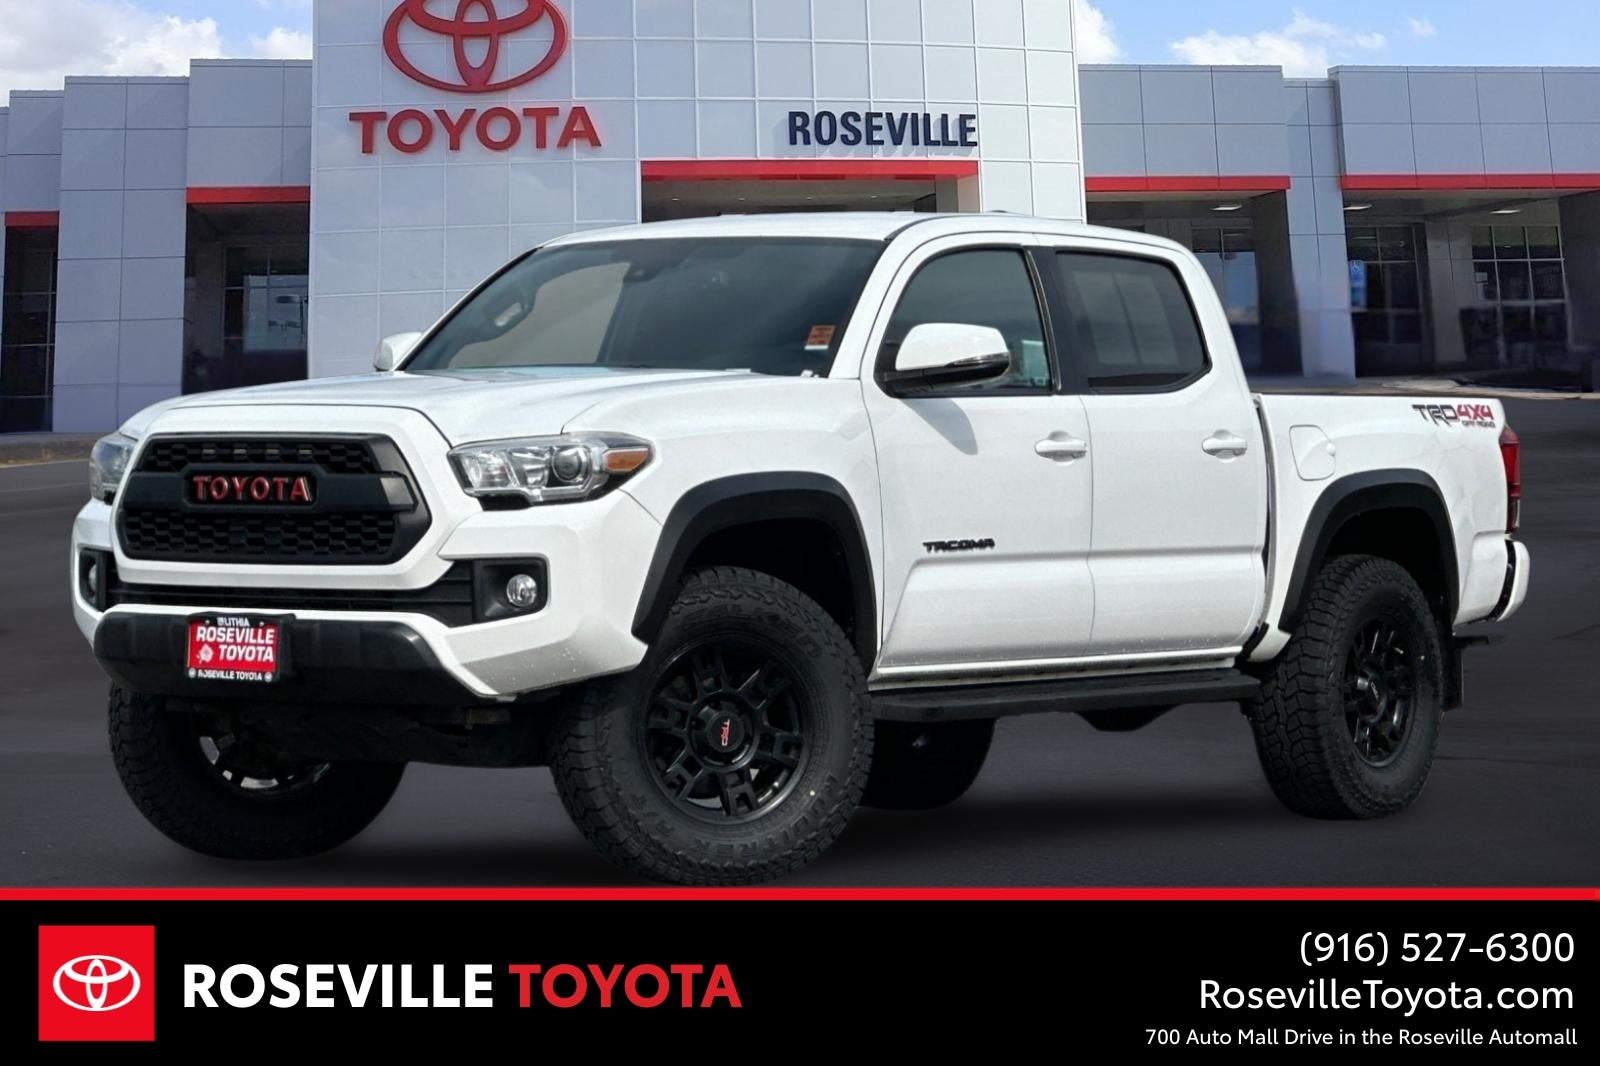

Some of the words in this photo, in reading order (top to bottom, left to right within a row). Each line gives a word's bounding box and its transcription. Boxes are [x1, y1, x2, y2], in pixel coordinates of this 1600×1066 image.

[349, 105, 602, 154] TOYOTA
[788, 110, 979, 148] ROSEVILLE
[1412, 404, 1458, 427] TRD
[192, 475, 312, 502] TOYOTA
[922, 538, 996, 553] TACOMA
[224, 617, 250, 627] LITHIA
[196, 626, 275, 644] ROSEVILLE
[219, 644, 274, 662] TOYOTA
